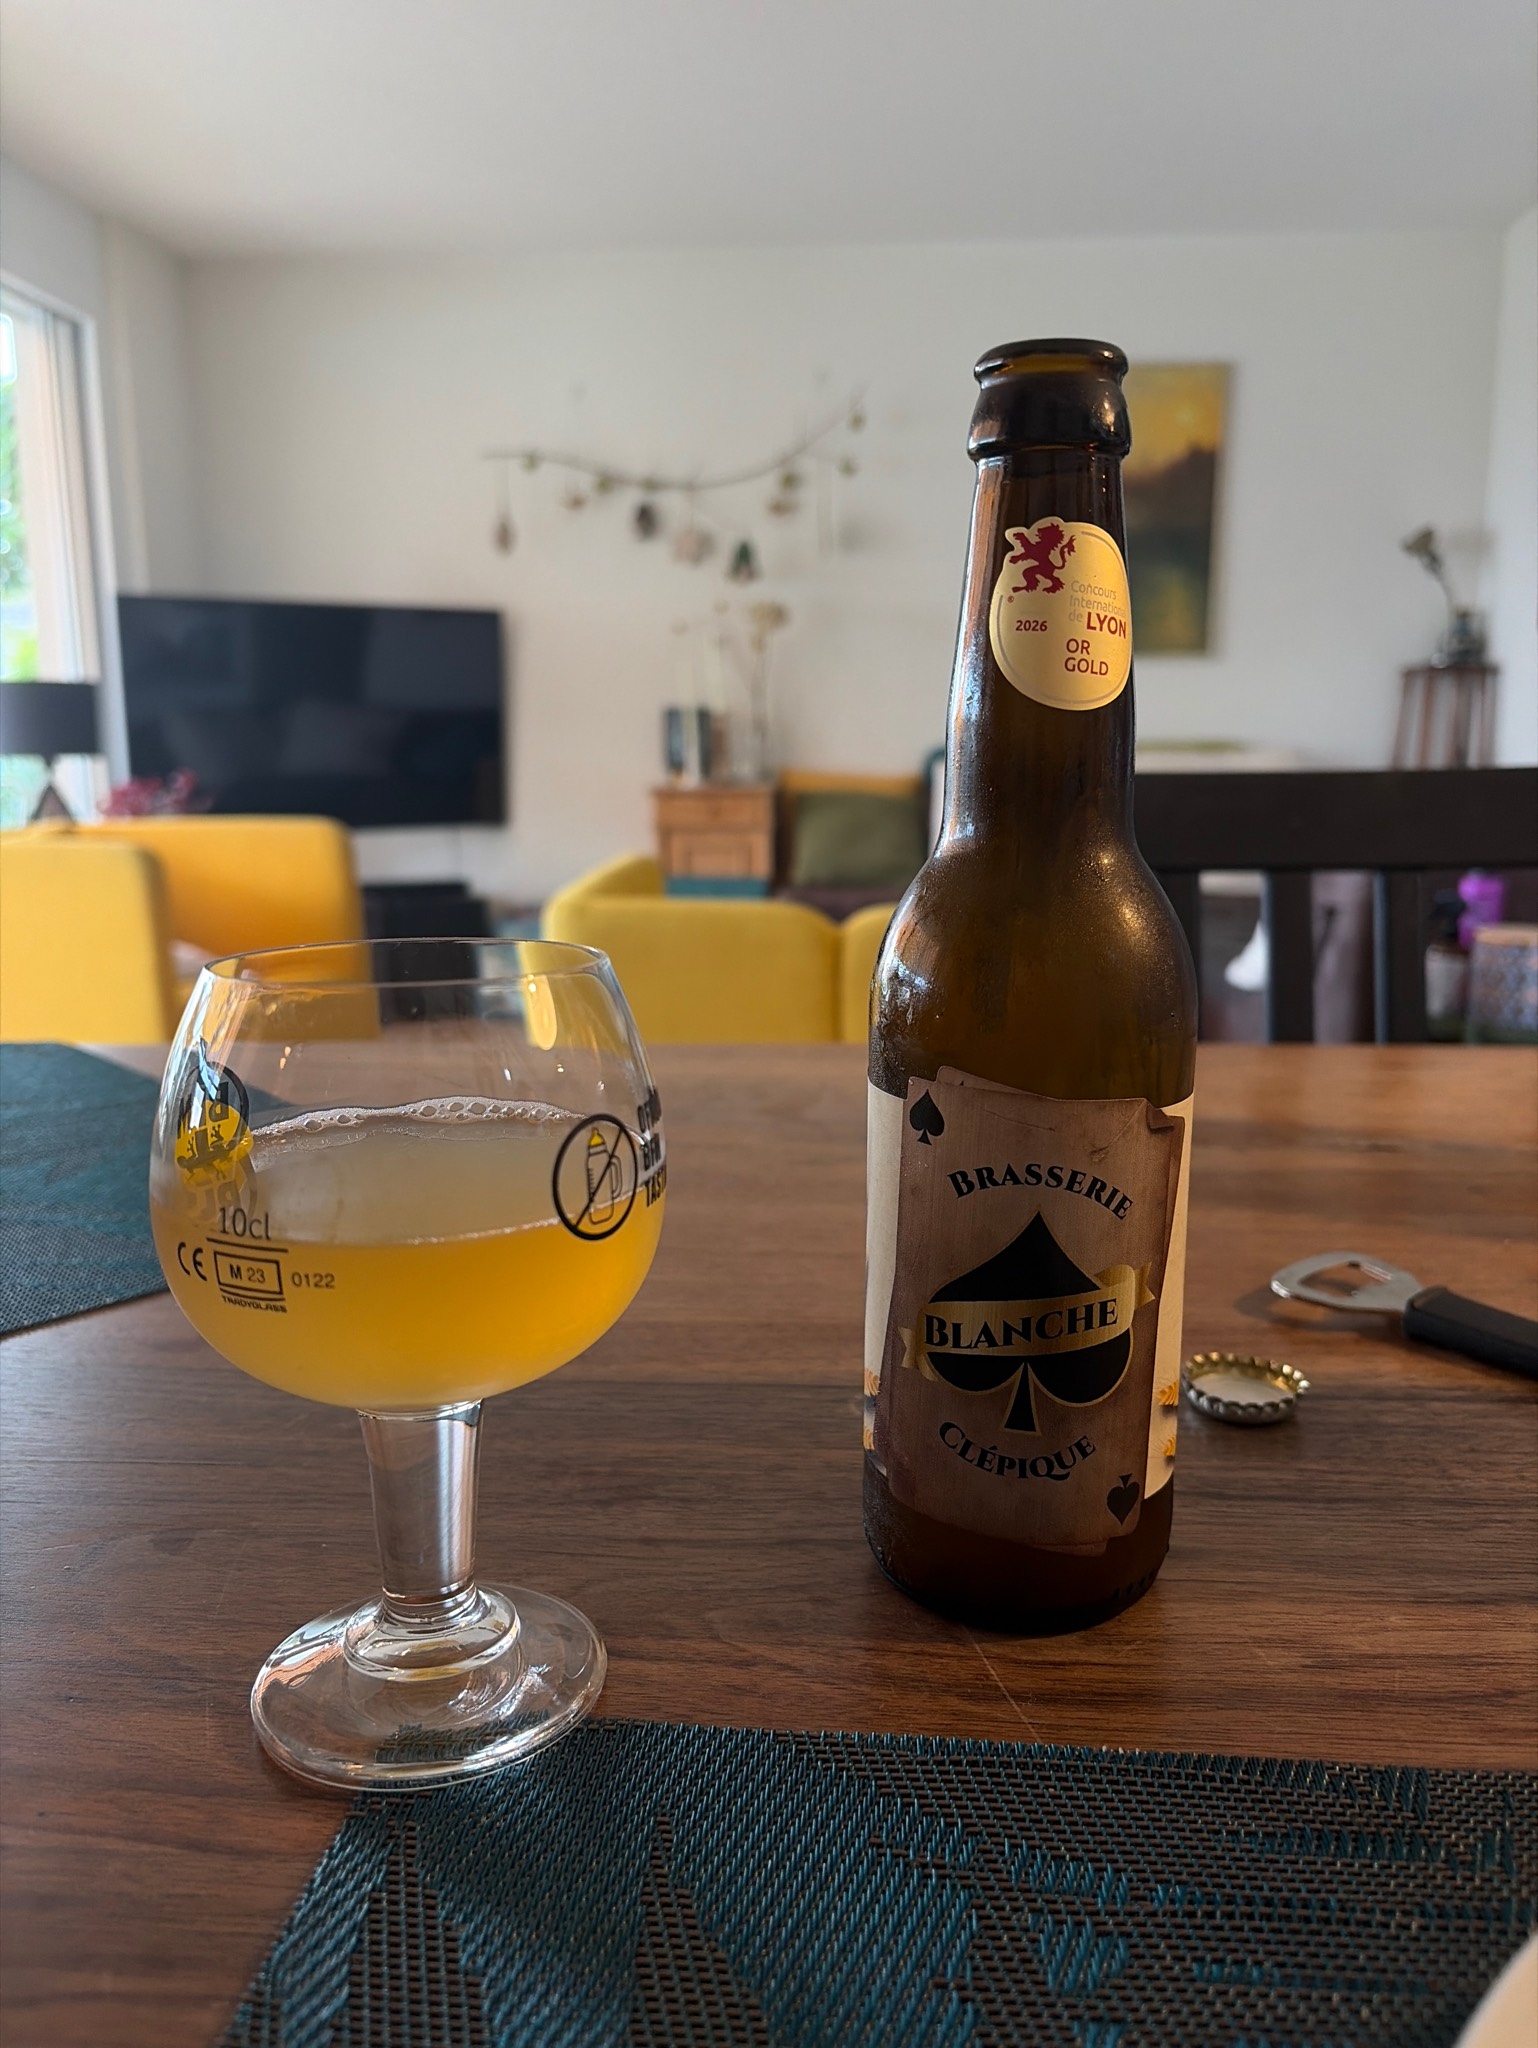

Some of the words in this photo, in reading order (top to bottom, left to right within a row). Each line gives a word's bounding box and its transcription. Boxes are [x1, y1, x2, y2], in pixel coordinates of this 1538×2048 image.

[1071, 580, 1117, 600] Concours
[1015, 620, 1048, 632] 2026
[1067, 610, 1084, 623] de
[1086, 611, 1127, 639] LYON
[1066, 638, 1091, 655] OR
[1064, 657, 1109, 676] GOLD
[947, 1163, 1134, 1221] BRASSERIE
[219, 1207, 272, 1241] 10cl
[229, 1264, 243, 1280] M
[247, 1267, 266, 1284] 23
[291, 1271, 335, 1289] 0122
[923, 1297, 1120, 1350] BLANCHE
[939, 1421, 1098, 1481] CLÉPIQUE
